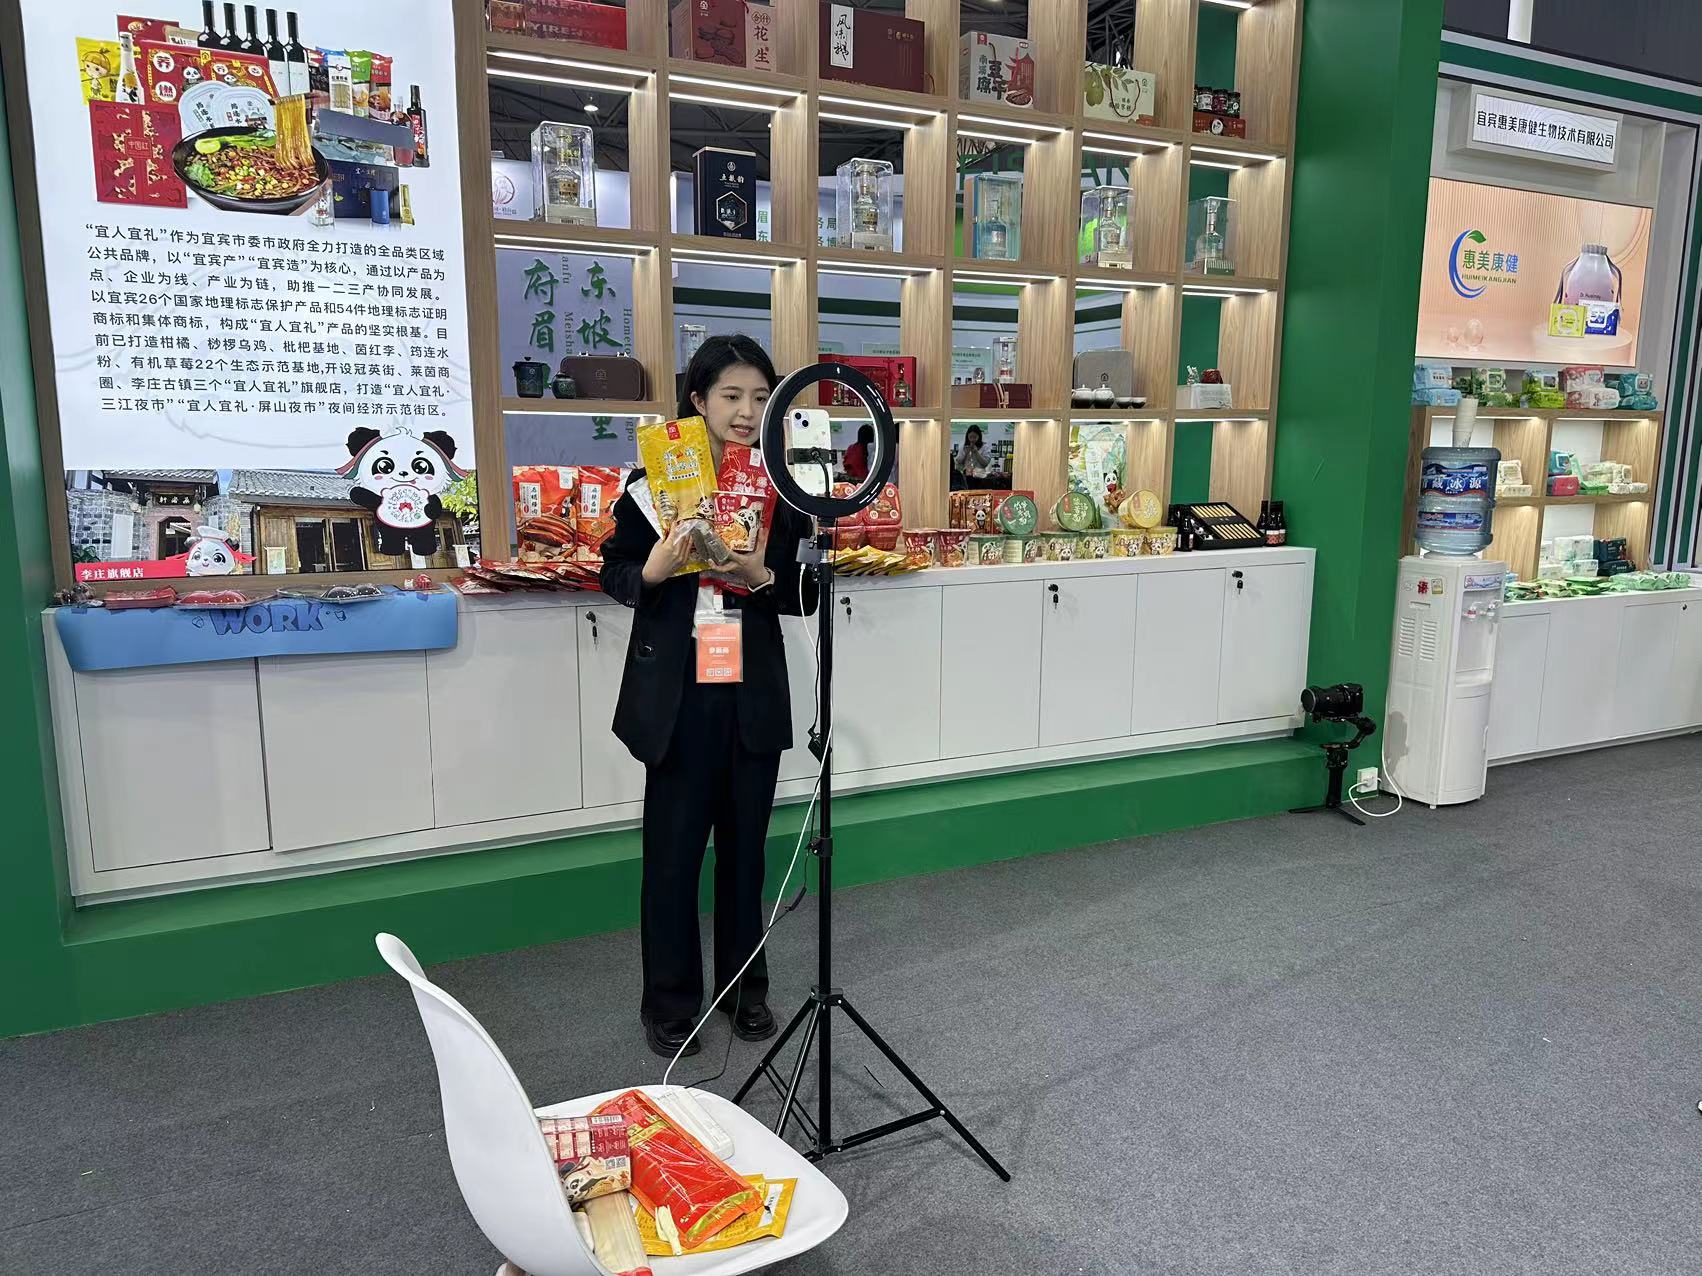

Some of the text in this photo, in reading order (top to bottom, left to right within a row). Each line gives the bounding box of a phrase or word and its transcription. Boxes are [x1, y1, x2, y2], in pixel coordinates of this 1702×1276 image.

[753, 26, 770, 64] 花生
[1476, 110, 1614, 150] 宜宾惠美康健生物技术有限公司
[1462, 249, 1519, 274] 惠美康健
[89, 268, 442, 301] 点、企业为线、产业为链，助推一二三产协同发展。
[1461, 273, 1518, 285] HUIMEIKANGJIAN
[91, 290, 447, 321] 以宜宾26个国家地理标志保护产品和54件地理标志证明
[81, 567, 145, 581] 李庄旗舰店
[209, 600, 324, 636] WORK
